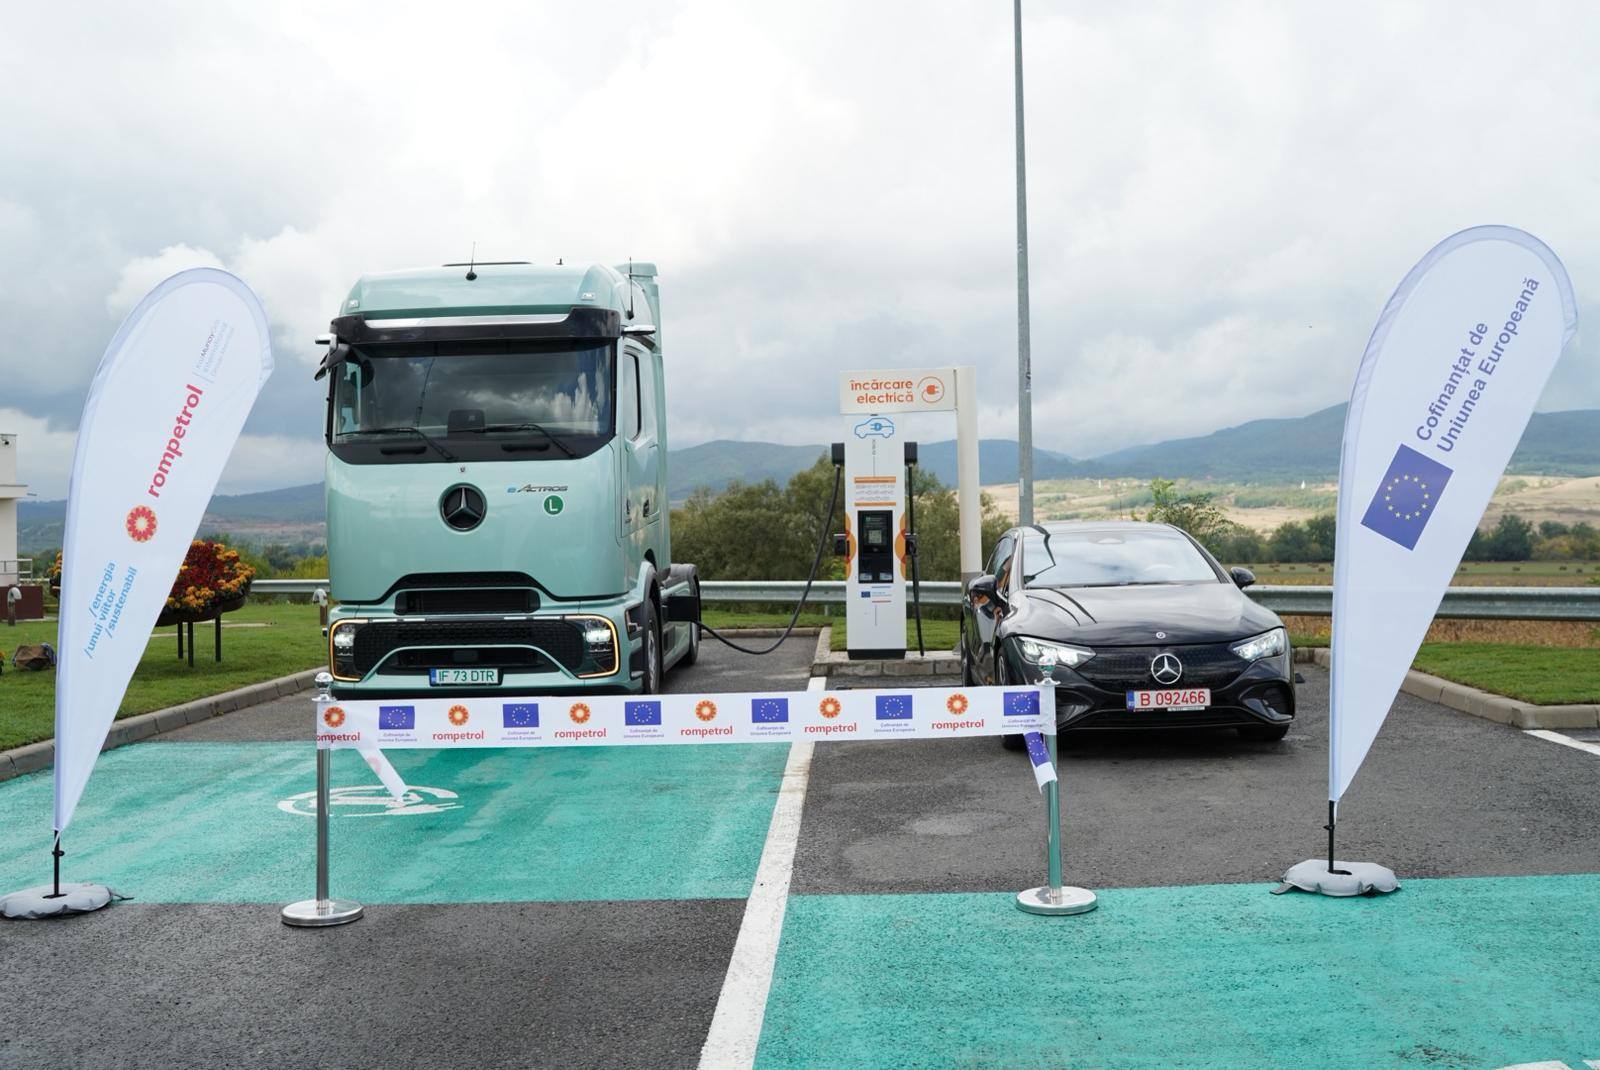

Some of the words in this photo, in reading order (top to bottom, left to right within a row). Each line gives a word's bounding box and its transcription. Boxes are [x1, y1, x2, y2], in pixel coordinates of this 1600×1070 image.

[1436, 378, 1487, 452] Uniunea
[1478, 277, 1540, 376] Europeană
[849, 379, 913, 391] încărcare
[1416, 347, 1475, 441] Cofinanțat
[1469, 322, 1488, 346] de
[856, 391, 914, 404] electrică
[148, 384, 204, 498] rompetrol
[549, 499, 558, 512] L
[99, 589, 116, 621] viitor
[438, 670, 449, 682] IF
[453, 670, 467, 682] 73
[470, 670, 494, 682] DTR
[1140, 693, 1151, 706] B
[1155, 691, 1206, 706] 092466
[804, 723, 857, 735] rompetrol
[931, 719, 985, 731] rompetrol
[316, 732, 361, 743] ompetrol
[432, 730, 484, 742] rompetrol
[554, 728, 607, 740] rompetrol
[680, 726, 733, 738] rompetrol
